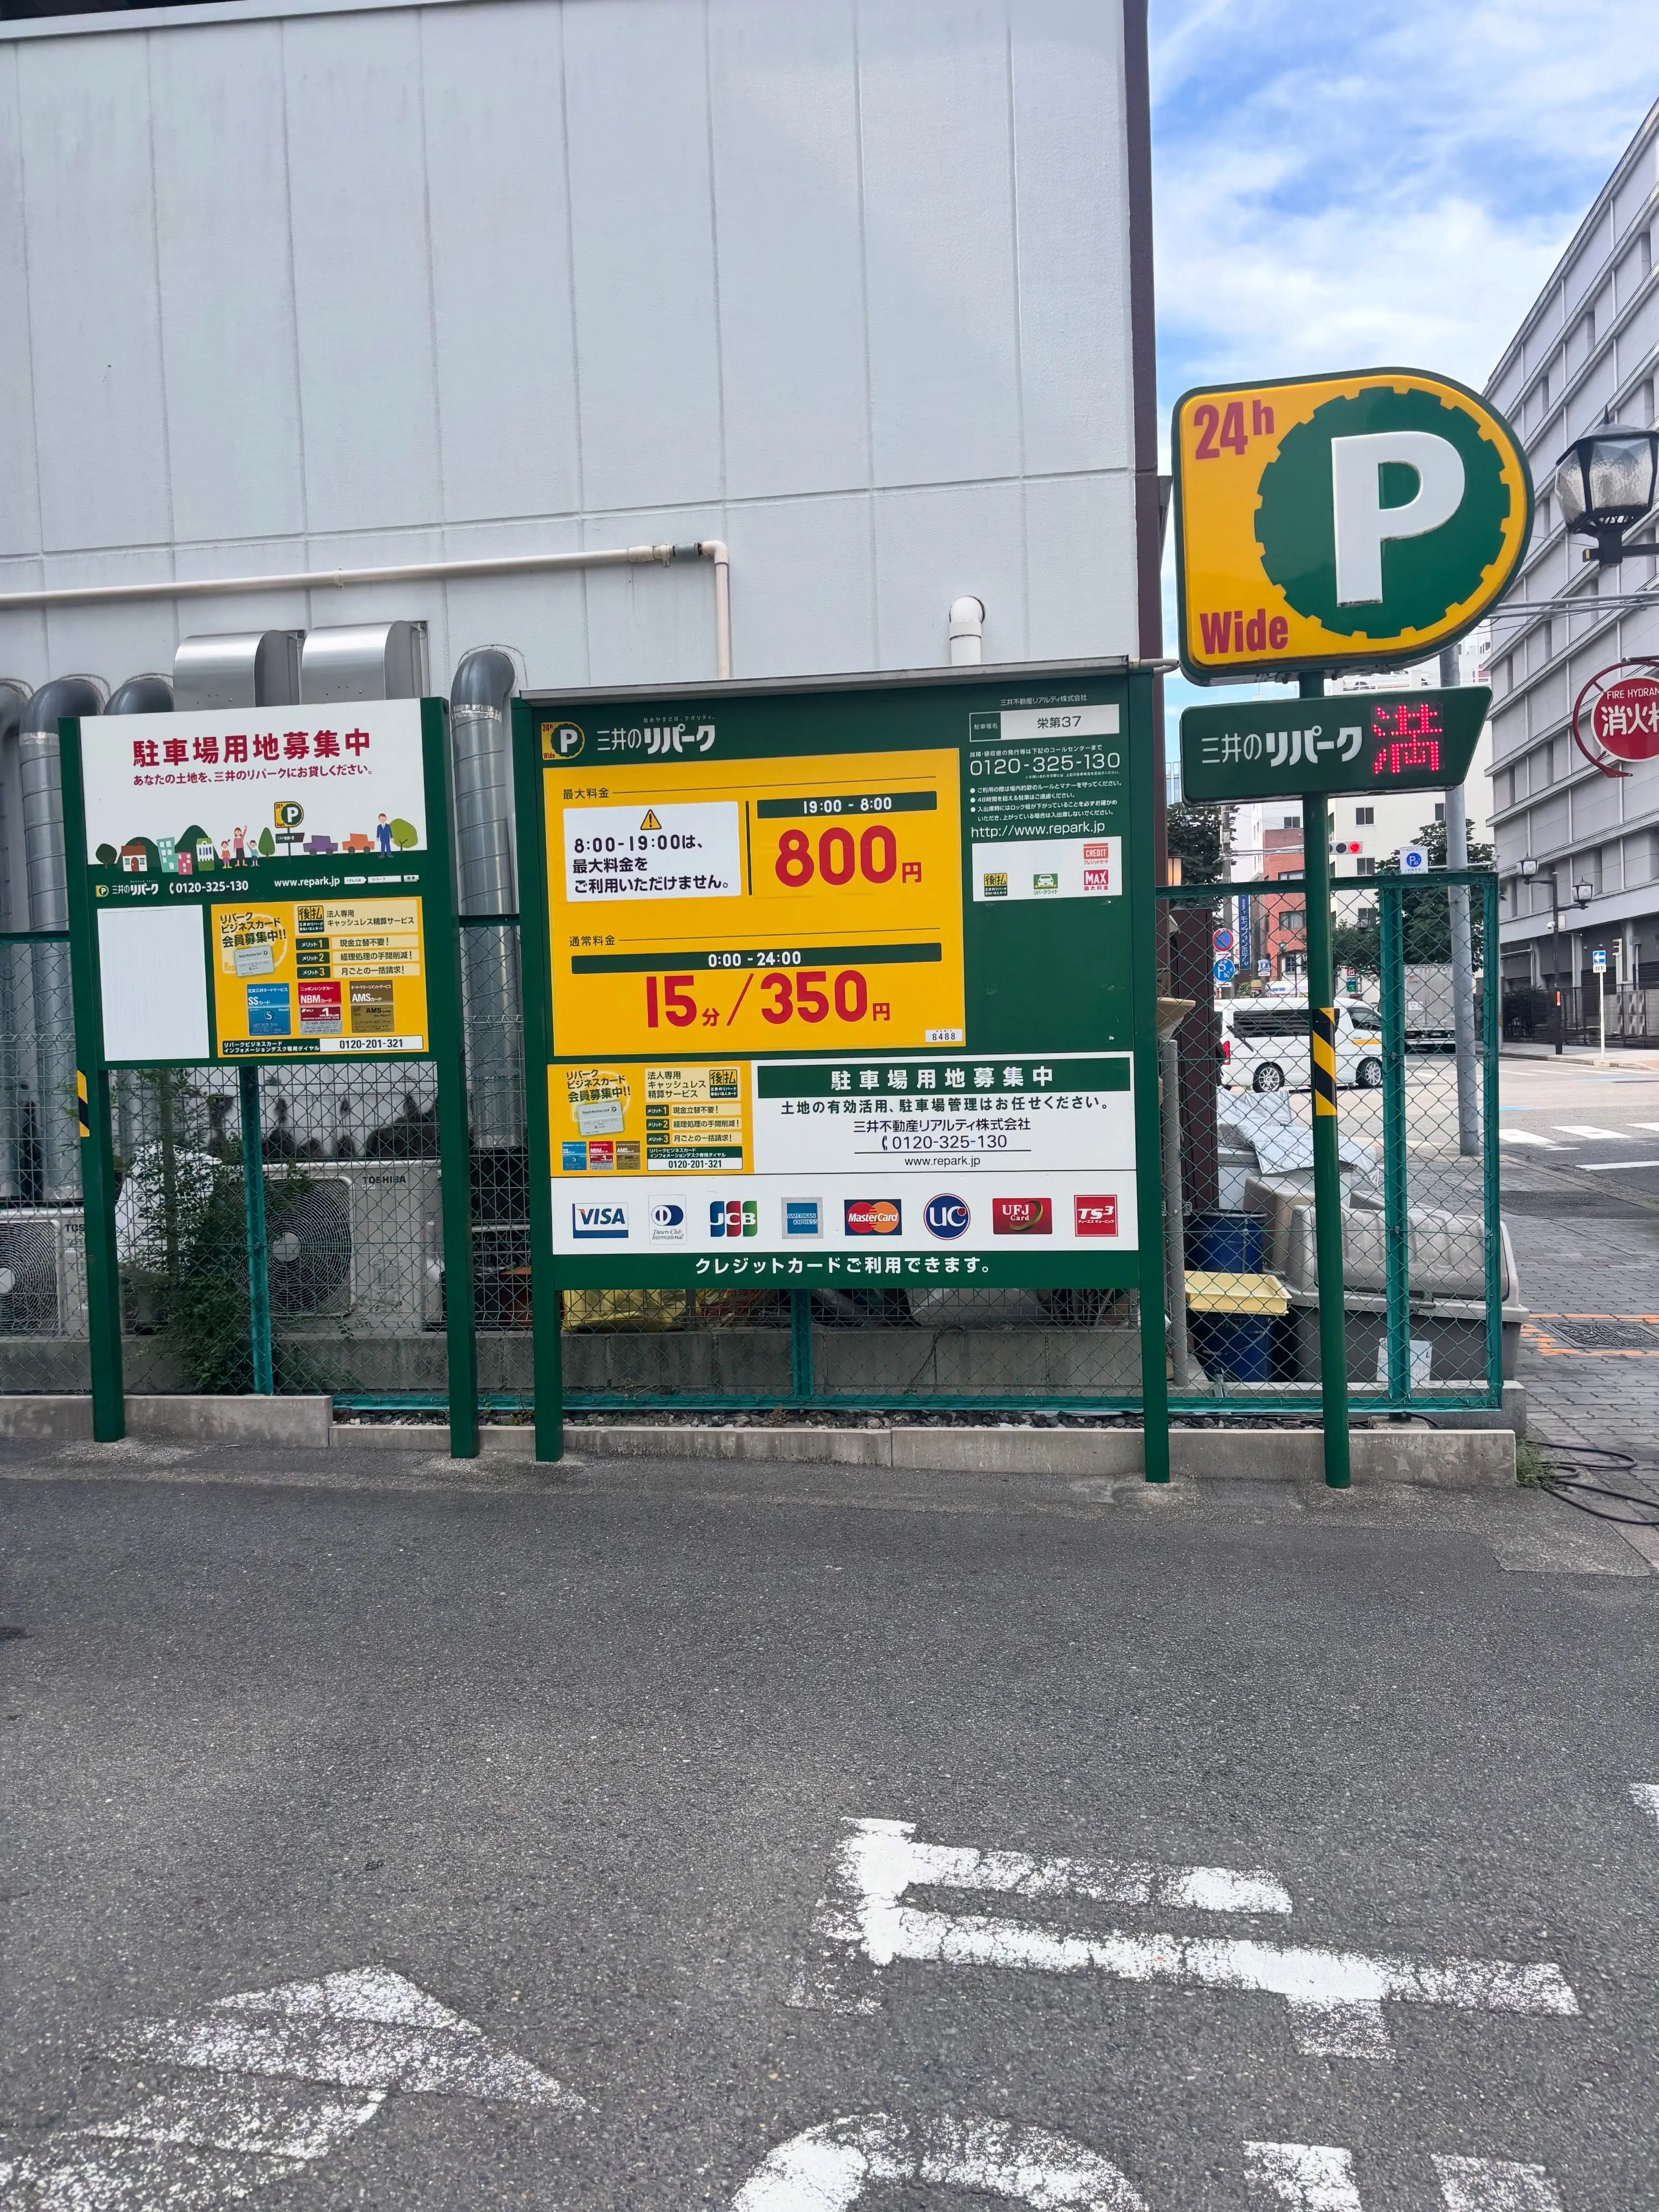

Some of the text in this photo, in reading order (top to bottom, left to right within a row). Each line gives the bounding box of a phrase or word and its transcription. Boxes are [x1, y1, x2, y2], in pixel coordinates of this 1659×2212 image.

[1194, 400, 1274, 460] 24h
[1331, 431, 1465, 607] P
[1200, 609, 1289, 655] Wide
[1000, 694, 1087, 706] 三井不動産リアルティ株式会社
[1607, 690, 1624, 699] FIRE
[1037, 716, 1081, 729] 栄第37
[560, 730, 578, 753] P
[597, 724, 715, 754] 三井のリパーク
[1373, 703, 1442, 774] 満
[133, 728, 370, 768] 駐車場用地募集中
[1201, 726, 1363, 767] 三井のリパーク
[970, 753, 1121, 775] 0120-325-130
[133, 764, 372, 786] あなたの土地を、三井のリパークにお貸しください。
[563, 787, 609, 800] 最大料金
[804, 800, 841, 814] 19:00
[860, 797, 892, 811] 8:00
[287, 807, 299, 822] P
[972, 821, 1105, 838] http://www.repark.jp
[574, 834, 703, 853] 8:00-19:00は、
[573, 857, 648, 874] 最大料金を
[274, 876, 340, 888] www.repark.jp
[575, 874, 729, 894] ご利用いただけません。
[986, 875, 1007, 886] 後払
[1085, 871, 1107, 884] MAX
[112, 884, 158, 895] 三井のリパーク
[176, 881, 248, 893] 0120-325-130
[220, 912, 253, 923] リパーク
[299, 907, 322, 920] 後払
[221, 918, 280, 933] ビジネスカード
[327, 916, 414, 926] キャッシュレス精算サービス
[222, 929, 286, 948] 会員募集中!!
[340, 938, 388, 947] 現金立替不要！
[569, 935, 615, 947] 通常料金
[341, 952, 412, 961] 経理処理の手間削減！
[708, 953, 741, 968] 0:00
[757, 950, 801, 966] 24:00
[341, 966, 404, 975] 月ごとの一括請求！
[340, 1039, 403, 1049] 0120-201-321
[567, 1069, 598, 1080] リパーク
[648, 1071, 681, 1080] 法人専用
[711, 1071, 736, 1084] 後払
[831, 1066, 1053, 1091] 駐車場用地募集中
[568, 1075, 625, 1089] ビジネスカード
[648, 1080, 706, 1089] キャッシュレス
[568, 1086, 631, 1103] 会員募集中!!
[648, 1090, 698, 1099] 精算サービス
[781, 1095, 1108, 1115] 土地の有効活用、駐車場管理はお任せください。
[673, 1120, 739, 1128] 経理処理の手間削減！
[854, 1117, 1030, 1133] 三井不動産リアルティ株式会社
[674, 1134, 732, 1142] 月ごとの一括請求！
[892, 1136, 1007, 1150] 0120-325-130
[669, 1160, 721, 1168] 0120-201-321
[905, 1156, 980, 1168] www.repark.jp
[362, 1176, 406, 1184] TOSHIBA
[577, 1208, 625, 1225] VISA
[1002, 1205, 1029, 1215] UFJ
[710, 1212, 756, 1225] JCB
[848, 1212, 898, 1223] MasterCard
[928, 1206, 967, 1228] UC
[696, 1256, 989, 1273] クレジットカードご利用できます。
